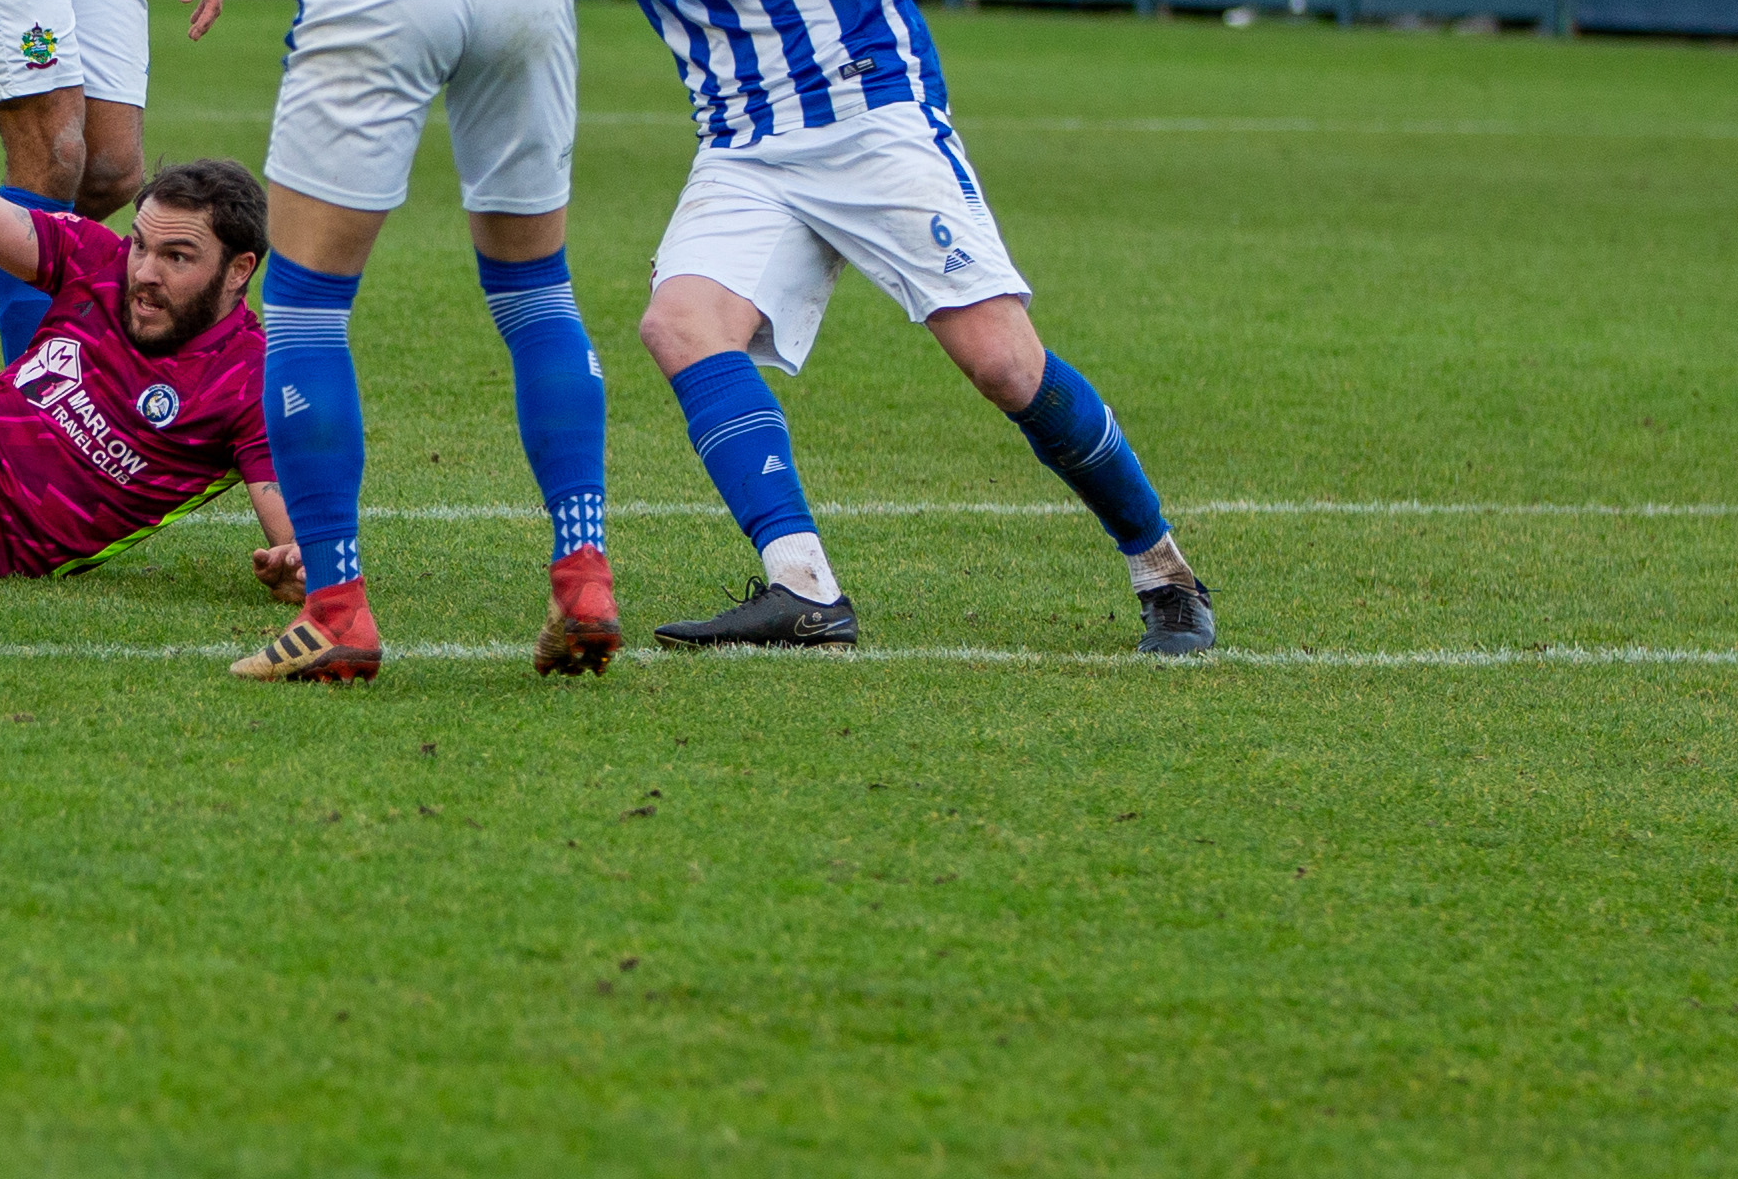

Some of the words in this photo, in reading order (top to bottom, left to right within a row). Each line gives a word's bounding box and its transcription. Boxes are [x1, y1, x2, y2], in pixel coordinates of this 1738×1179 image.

[930, 213, 952, 248] 6
[51, 404, 93, 455] TRAVEL
[91, 450, 131, 485] CLUB
[67, 389, 149, 475] MARLOW
